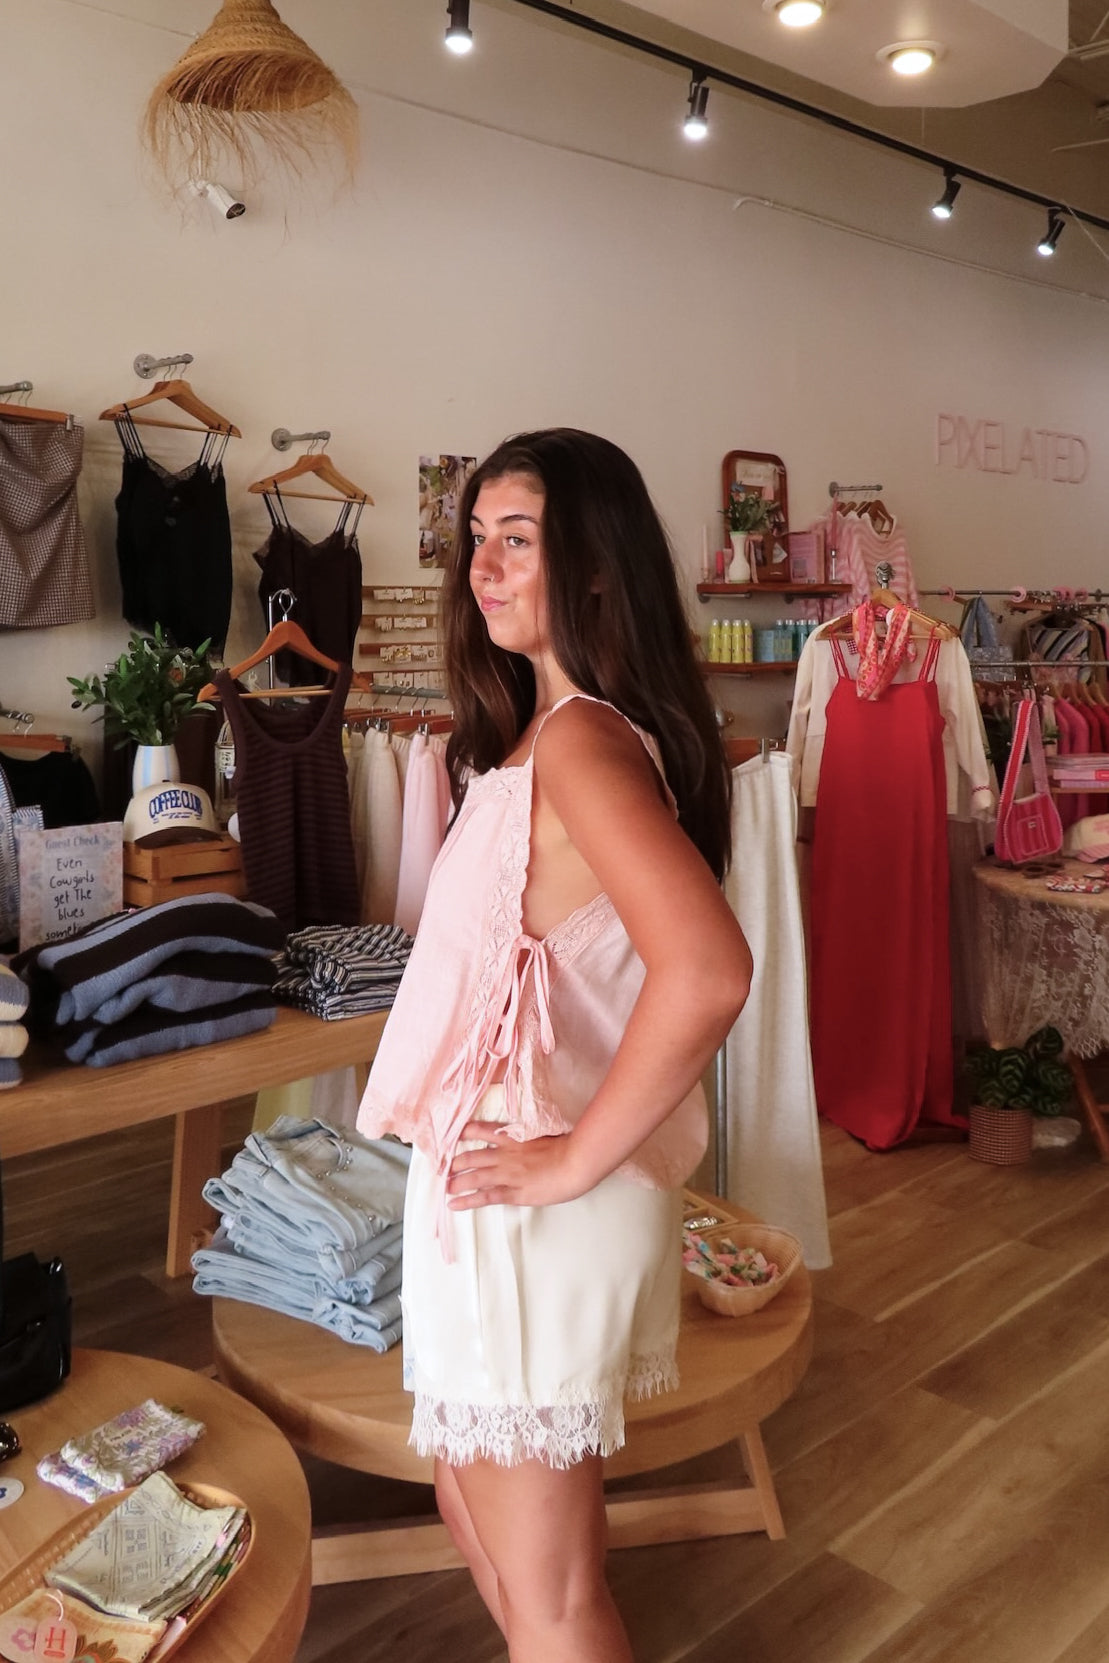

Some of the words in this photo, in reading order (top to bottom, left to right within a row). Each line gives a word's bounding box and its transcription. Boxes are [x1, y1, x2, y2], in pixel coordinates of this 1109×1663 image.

[936, 413, 1091, 484] PIXELATED
[149, 789, 182, 819] COFFEE
[181, 790, 203, 817] CLUB
[56, 858, 82, 871] Even
[54, 890, 69, 909] get
[58, 907, 85, 921] blues
